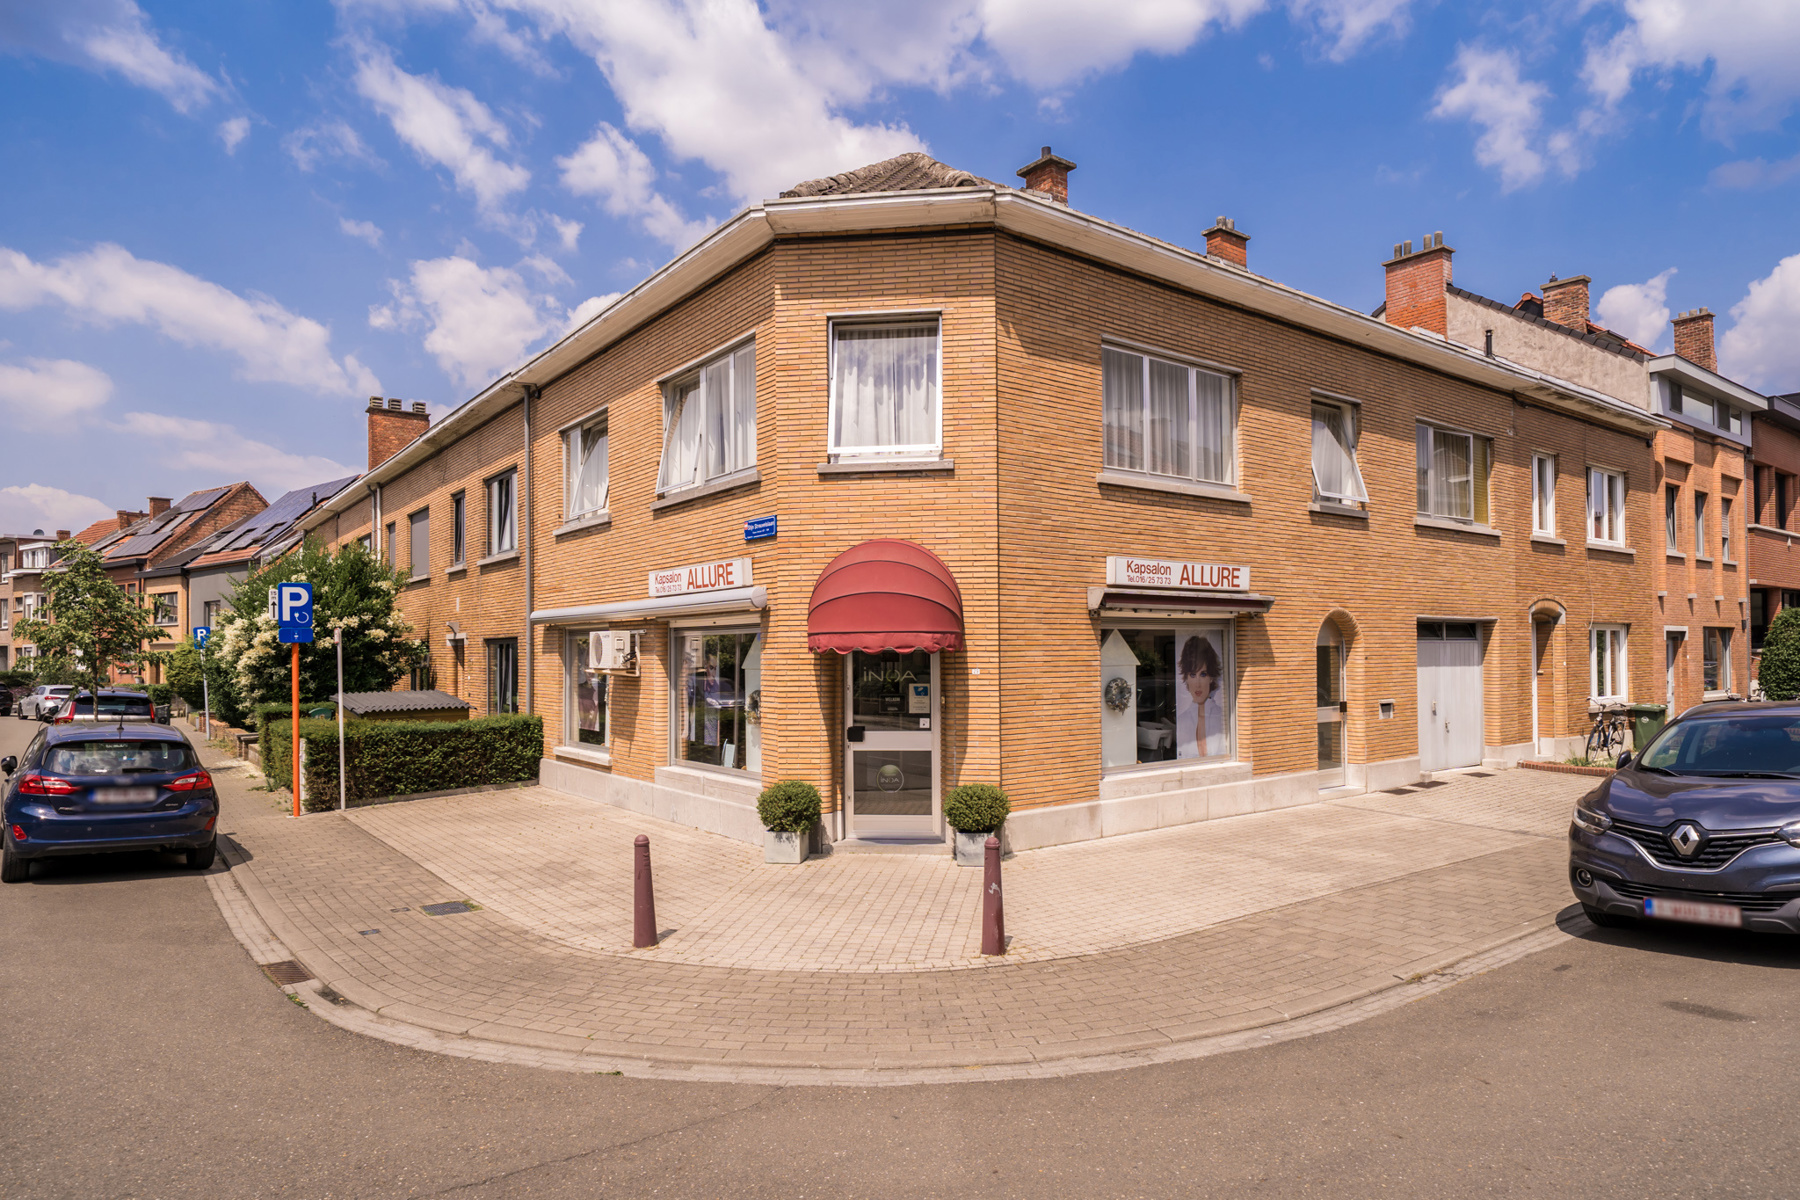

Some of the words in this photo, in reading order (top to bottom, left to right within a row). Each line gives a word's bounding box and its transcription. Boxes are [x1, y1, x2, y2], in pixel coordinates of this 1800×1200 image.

[655, 571, 682, 586] Kapsalon
[687, 562, 735, 590] ALLURE
[1126, 560, 1171, 576] Kapsalon
[1179, 564, 1241, 588] ALLURE
[282, 587, 309, 622] P
[197, 629, 206, 641] P
